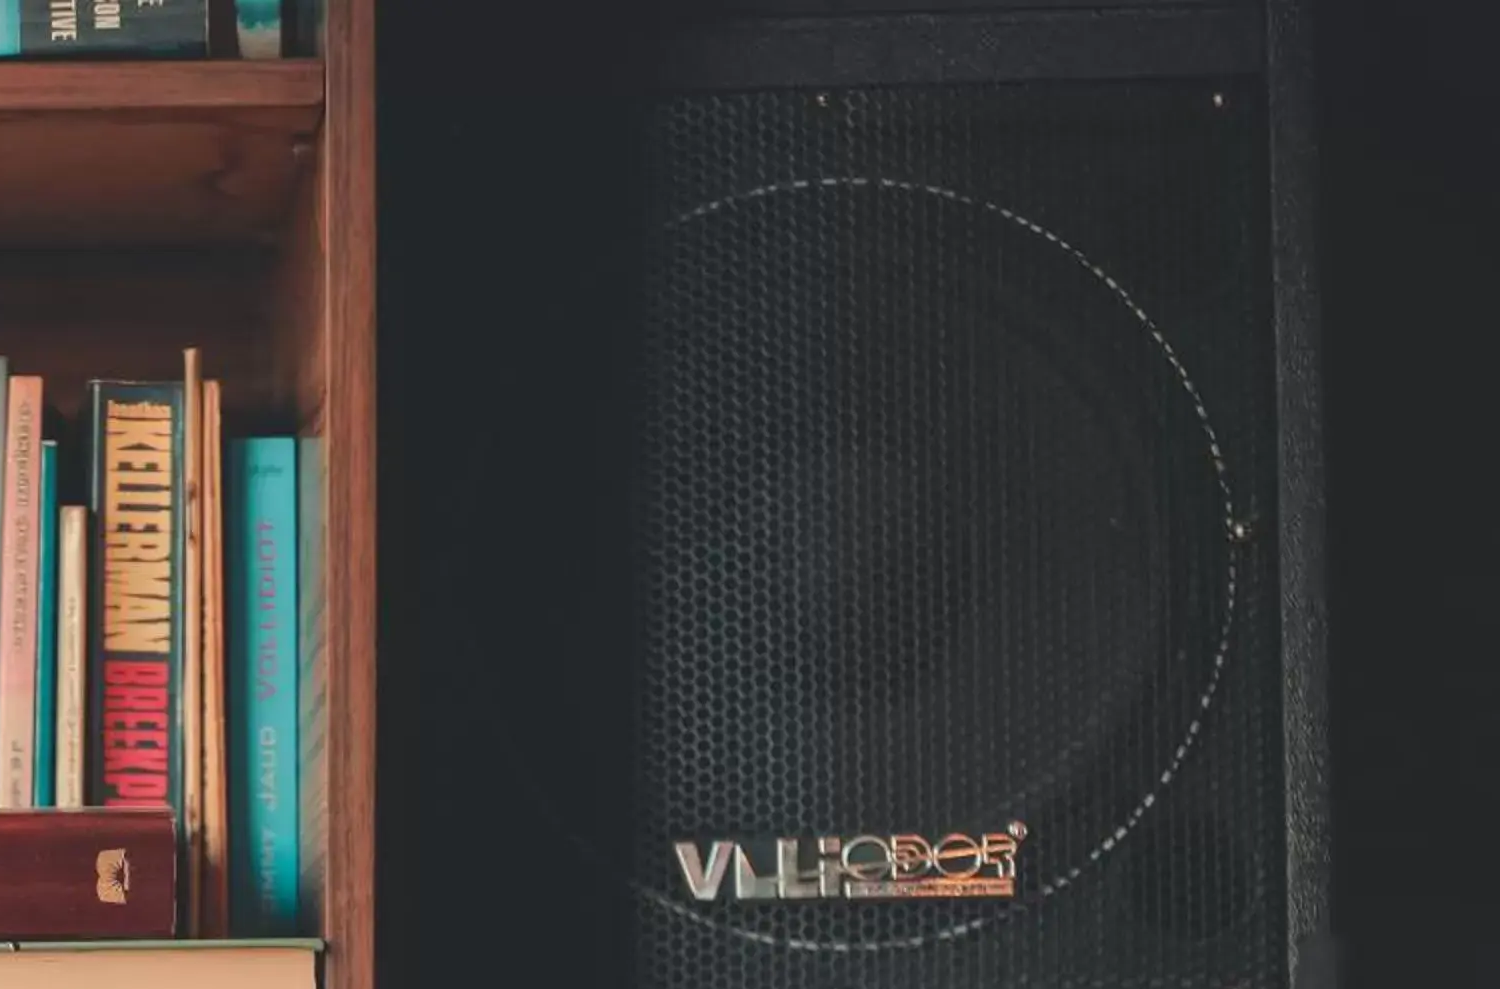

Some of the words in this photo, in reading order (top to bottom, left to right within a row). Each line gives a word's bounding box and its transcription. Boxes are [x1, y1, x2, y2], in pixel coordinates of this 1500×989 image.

[104, 416, 173, 653] KELLERMAN
[103, 661, 170, 808] BREEKP
[257, 725, 278, 812] JAUD
